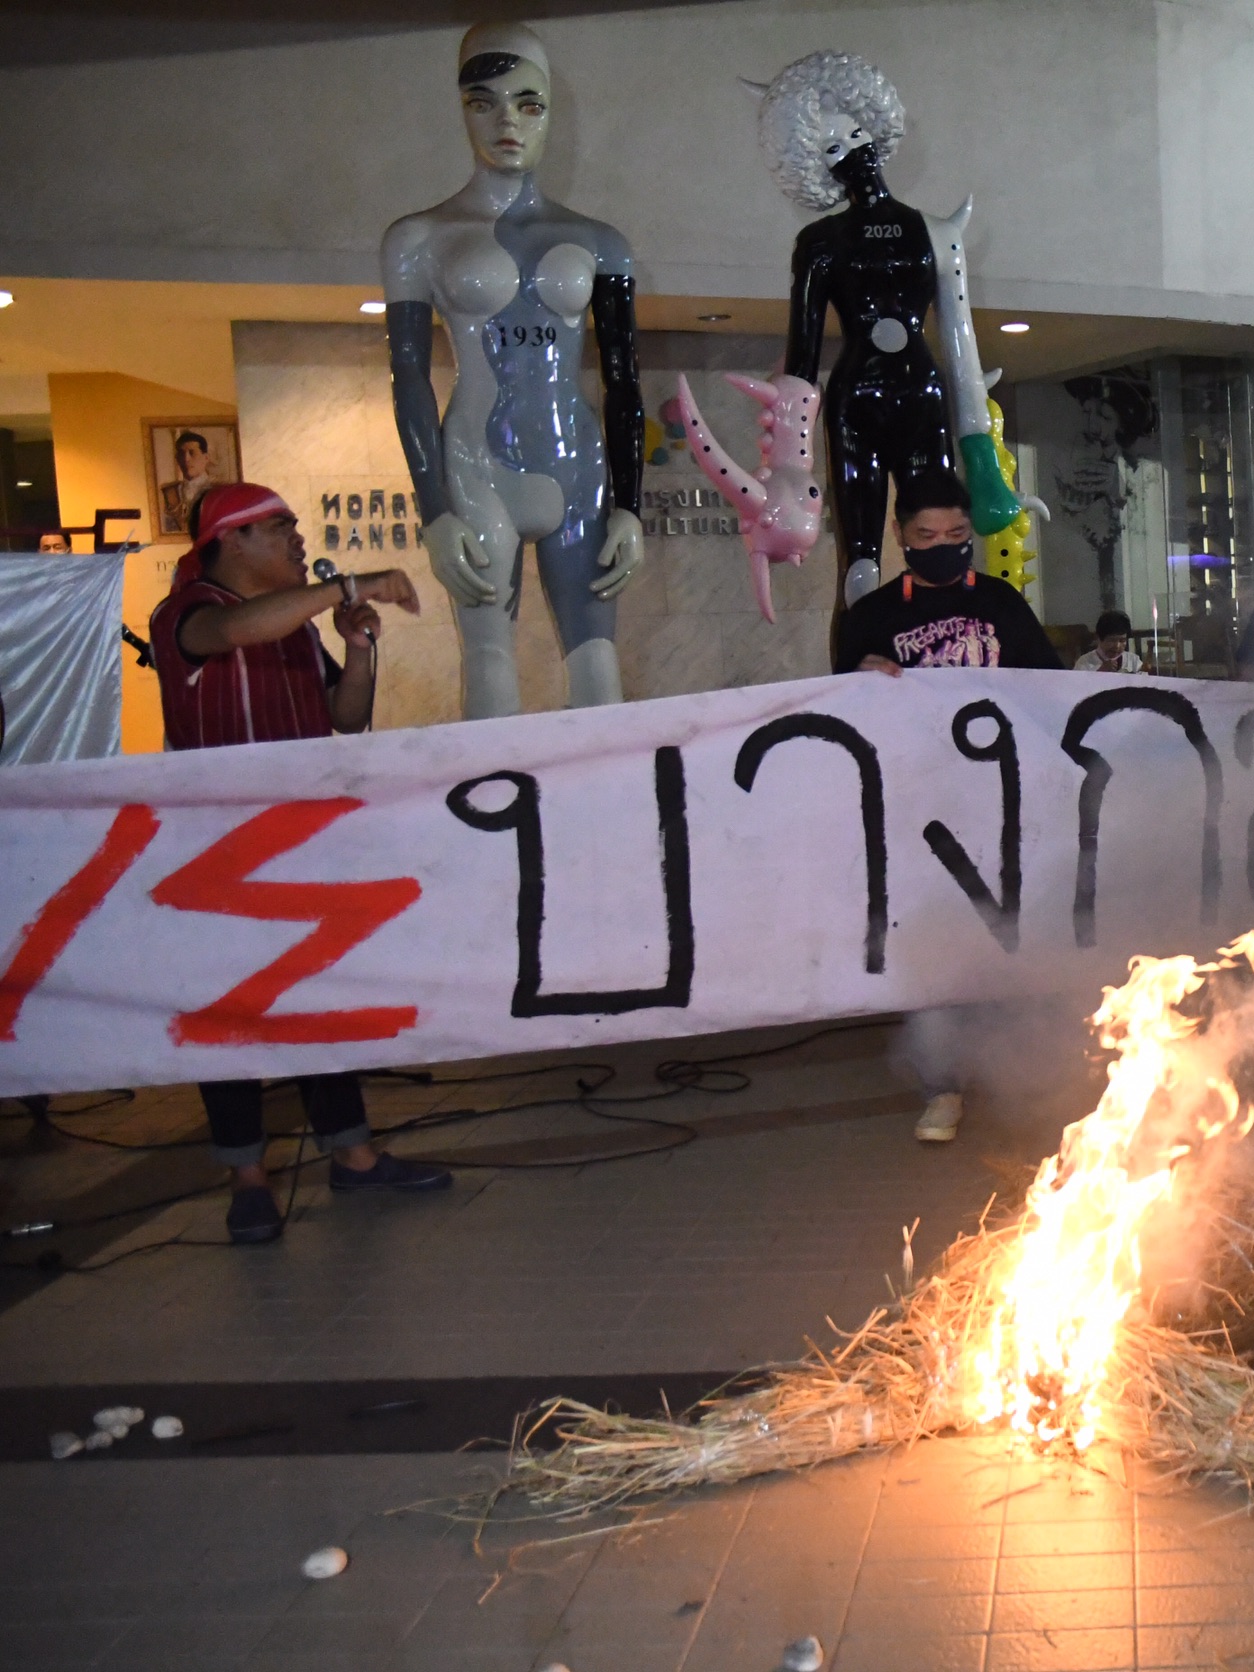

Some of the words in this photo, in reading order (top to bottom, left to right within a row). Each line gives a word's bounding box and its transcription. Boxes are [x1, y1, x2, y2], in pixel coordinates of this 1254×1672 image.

[863, 223, 903, 239] 2020
[498, 325, 558, 347] 1939
[644, 516, 742, 536] ULTUR
